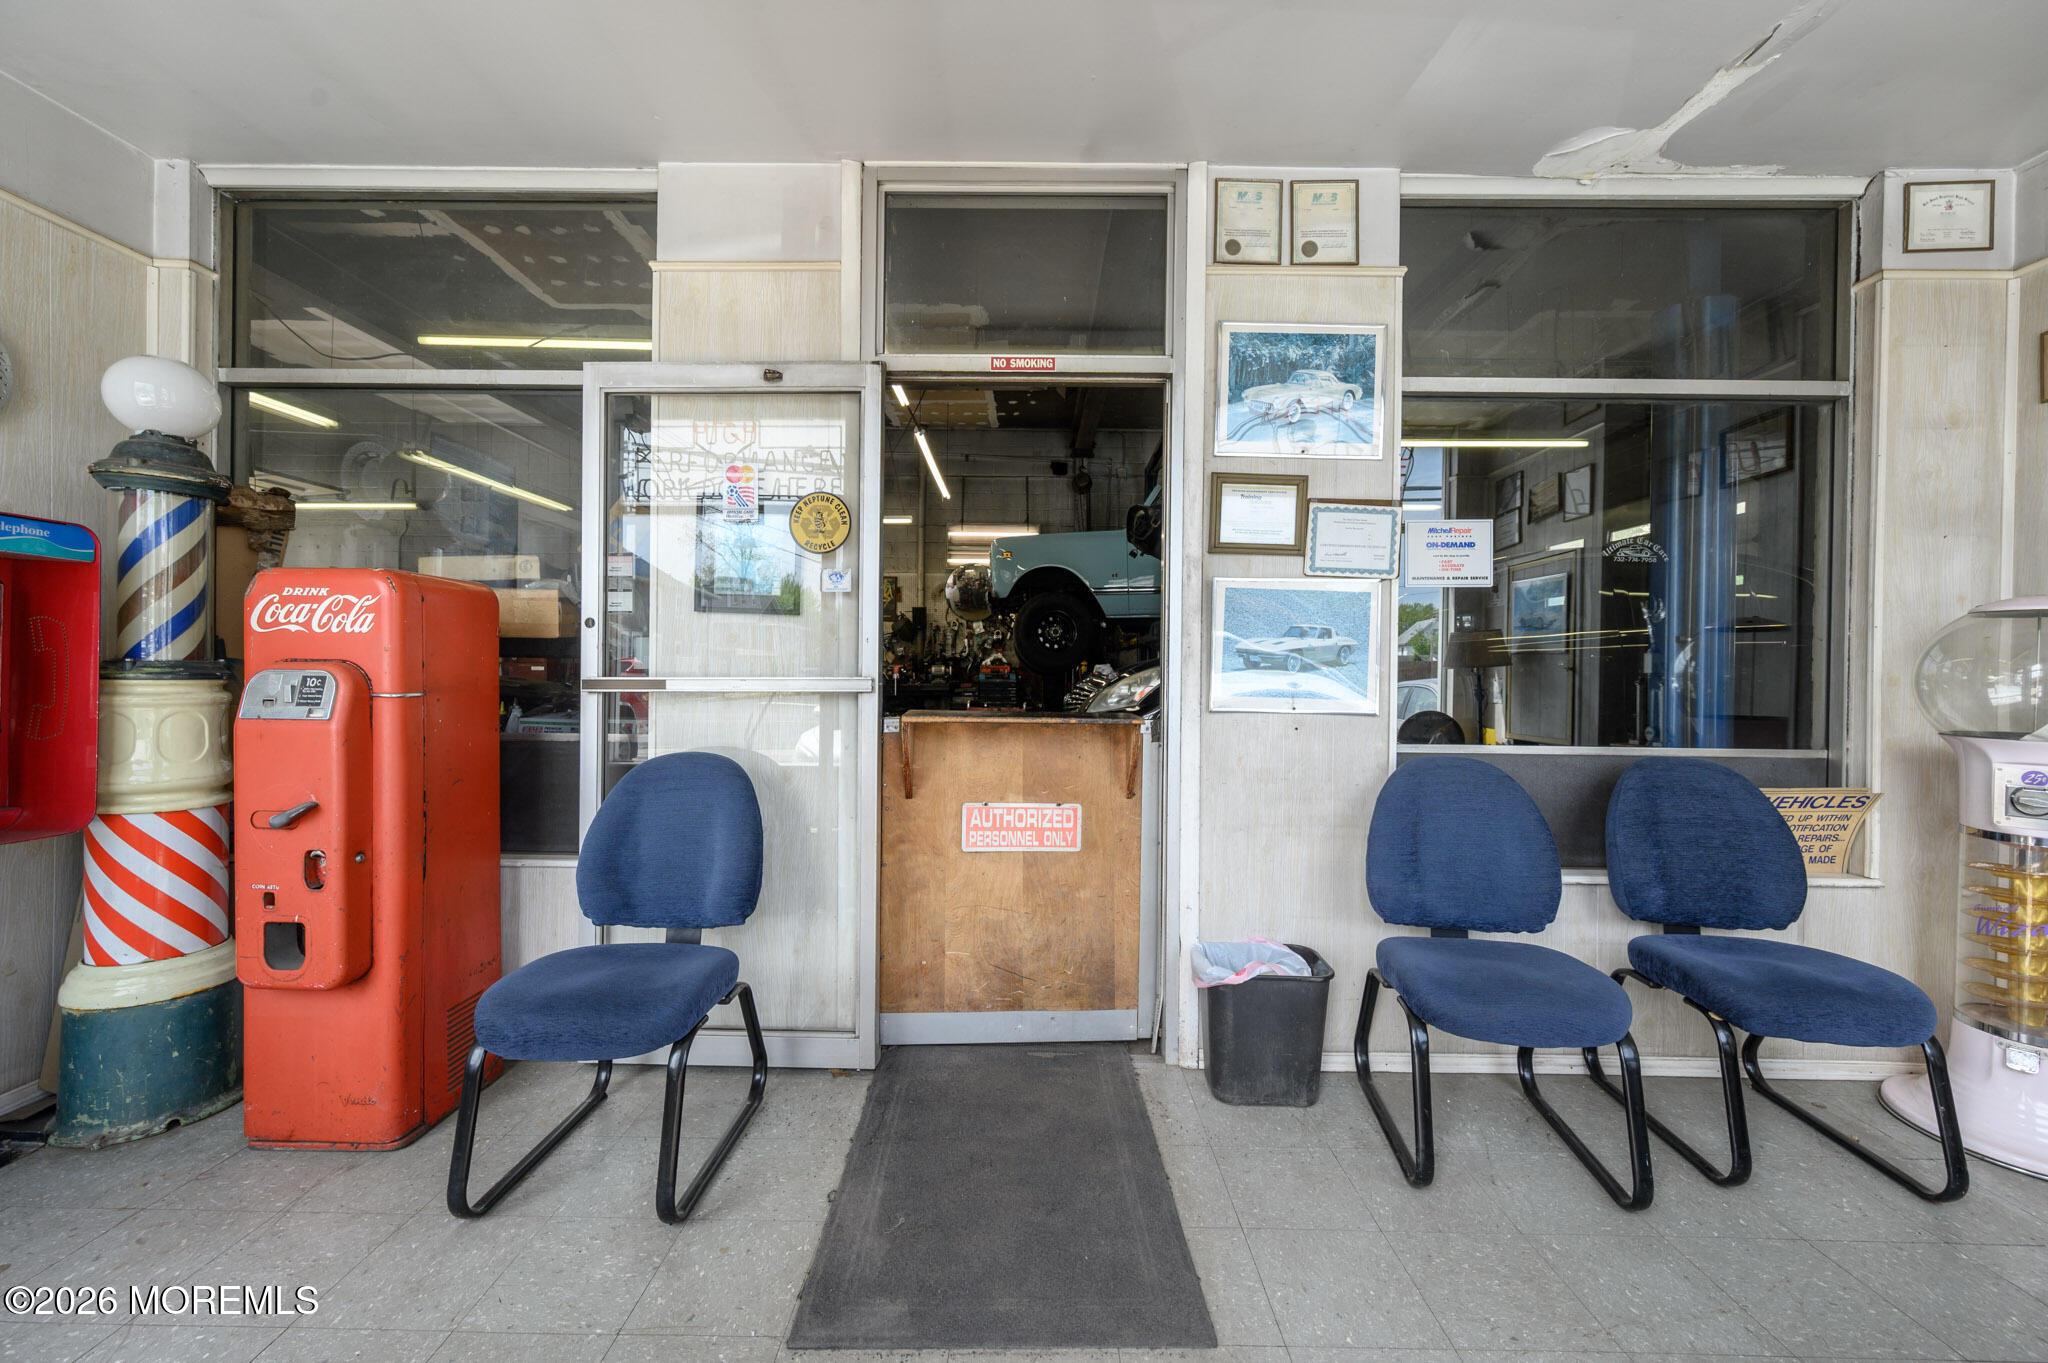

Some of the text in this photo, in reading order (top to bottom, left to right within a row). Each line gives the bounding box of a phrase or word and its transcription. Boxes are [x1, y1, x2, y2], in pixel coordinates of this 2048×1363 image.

[993, 358, 1053, 368] NO SMOKING
[803, 495, 835, 507] NEPTUNE
[834, 503, 848, 526] CLEAN
[0, 521, 50, 537] lephone
[804, 540, 836, 551] RECYCLE
[1426, 541, 1476, 549] ON-DEMAND
[282, 587, 330, 596] DRINK
[250, 593, 383, 634] Coca-Cola
[970, 808, 1074, 828] AUTHORIZED
[1782, 814, 1853, 822] ED UP WITHIN
[1791, 823, 1850, 832] OTIFICATION
[969, 831, 1073, 846] PERSONNEL ONLY
[1799, 844, 1834, 853] GE OF
[1808, 855, 1837, 864] MADE
